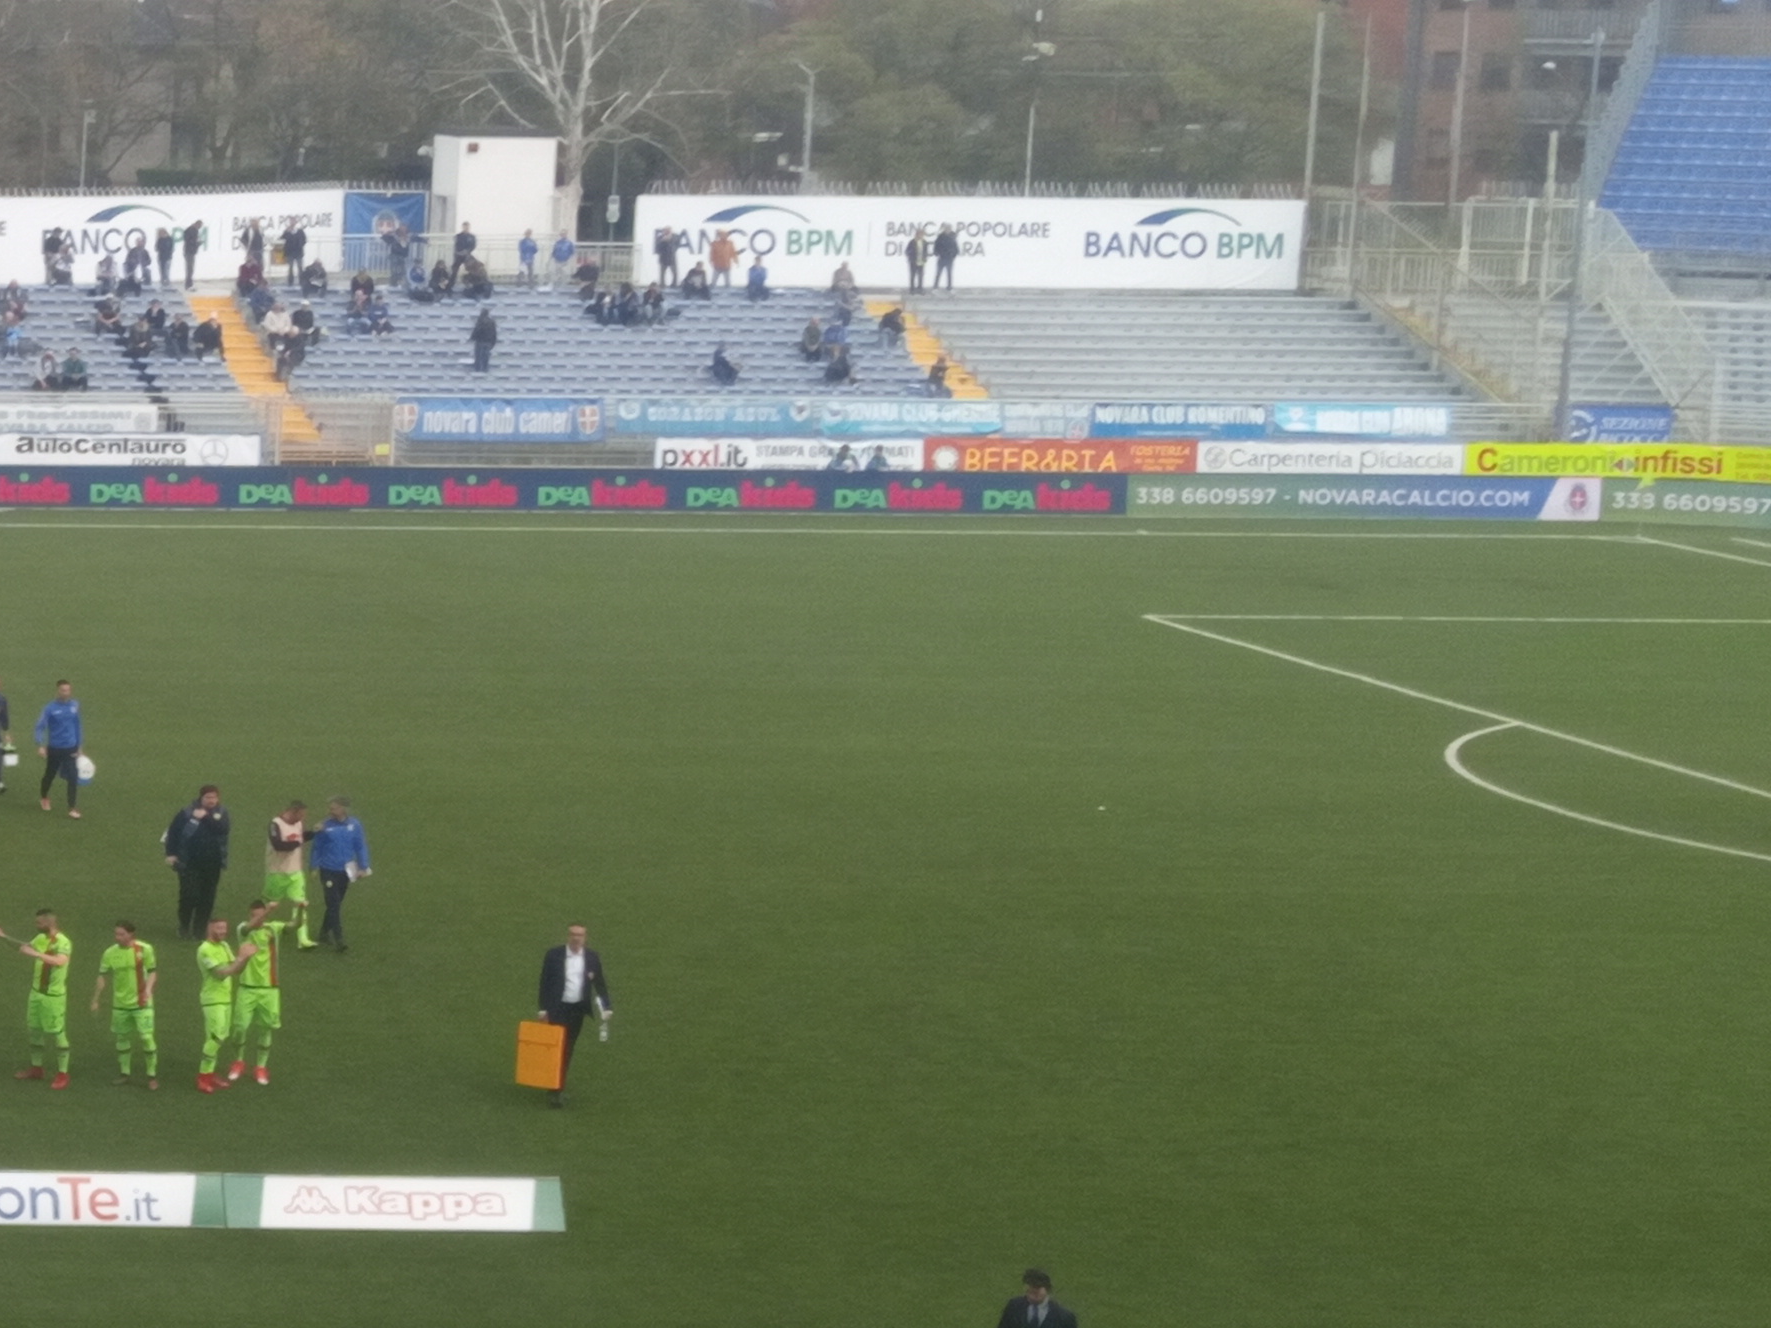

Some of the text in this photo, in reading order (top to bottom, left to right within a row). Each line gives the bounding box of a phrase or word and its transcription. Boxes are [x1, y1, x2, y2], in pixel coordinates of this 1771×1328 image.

[232, 216, 274, 232] BACA
[955, 222, 1051, 238] POPOLARE
[786, 229, 853, 256] BPM
[885, 241, 902, 257] DI
[1084, 231, 1284, 259] BANCO BPM
[422, 410, 477, 435] novara
[482, 407, 515, 435] club
[1095, 405, 1148, 424] NOVARA
[1152, 405, 1184, 424] CLUB
[1188, 406, 1266, 425] ROMENTINO
[755, 445, 805, 458] STAMPA
[1228, 449, 1353, 473] Carpenteria
[1476, 447, 1616, 475] Cameroni
[1633, 449, 1724, 476] infissi
[1136, 487, 1531, 507] 338 6609597 NOVARACALCIO.COM
[355, 1185, 507, 1220] Kappa
